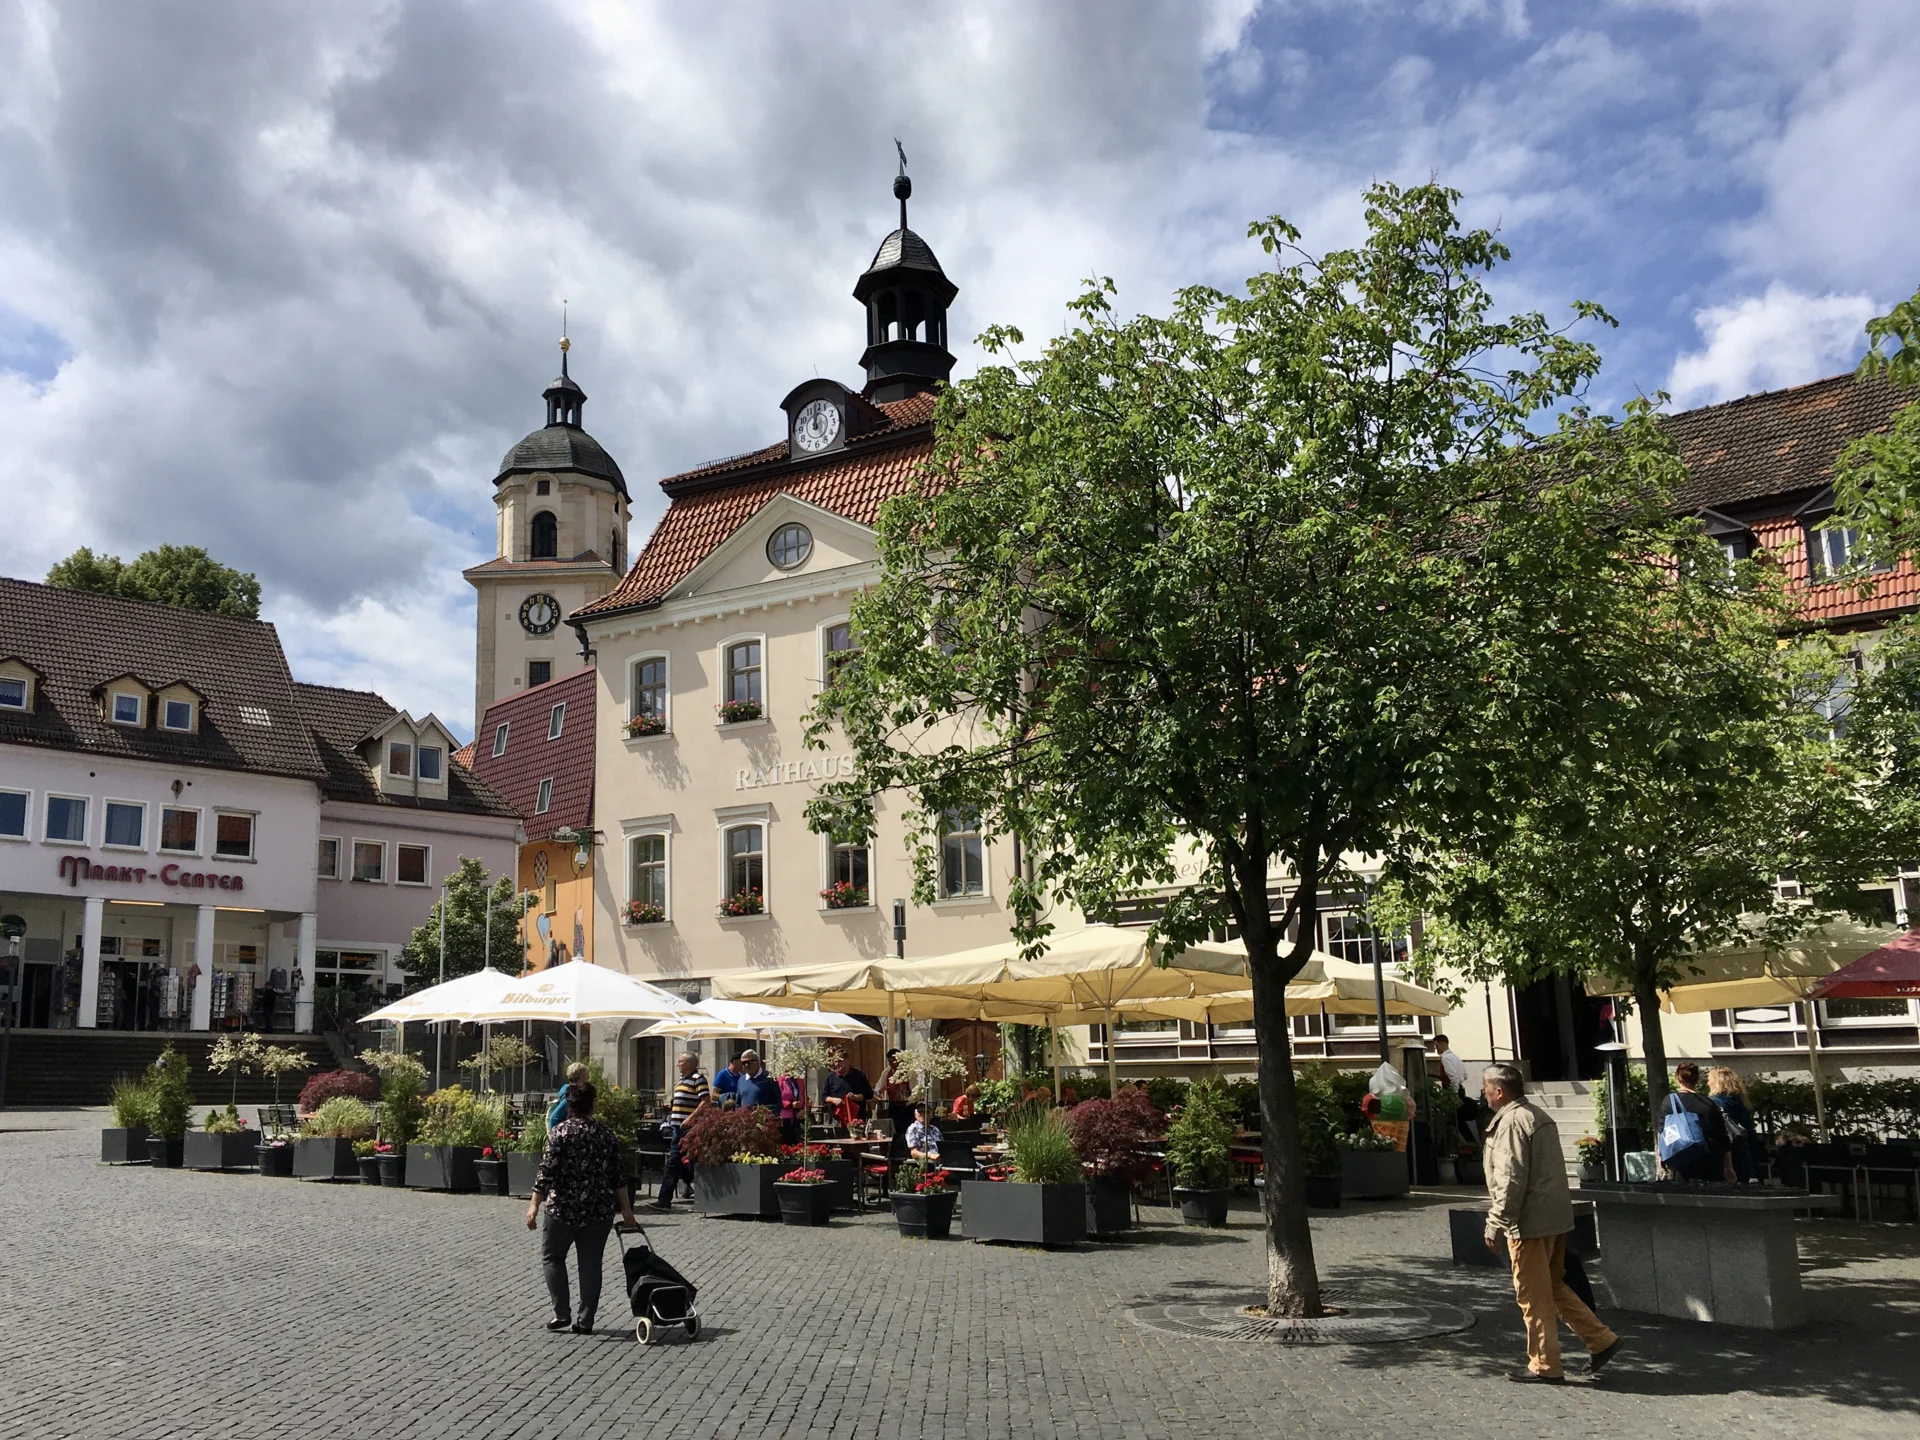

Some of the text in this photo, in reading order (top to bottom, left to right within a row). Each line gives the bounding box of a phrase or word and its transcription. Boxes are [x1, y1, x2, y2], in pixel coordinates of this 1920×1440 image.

[735, 754, 855, 791] RATHAUS
[1165, 853, 1283, 879] Restt
[499, 992, 572, 1005] Bitburger
